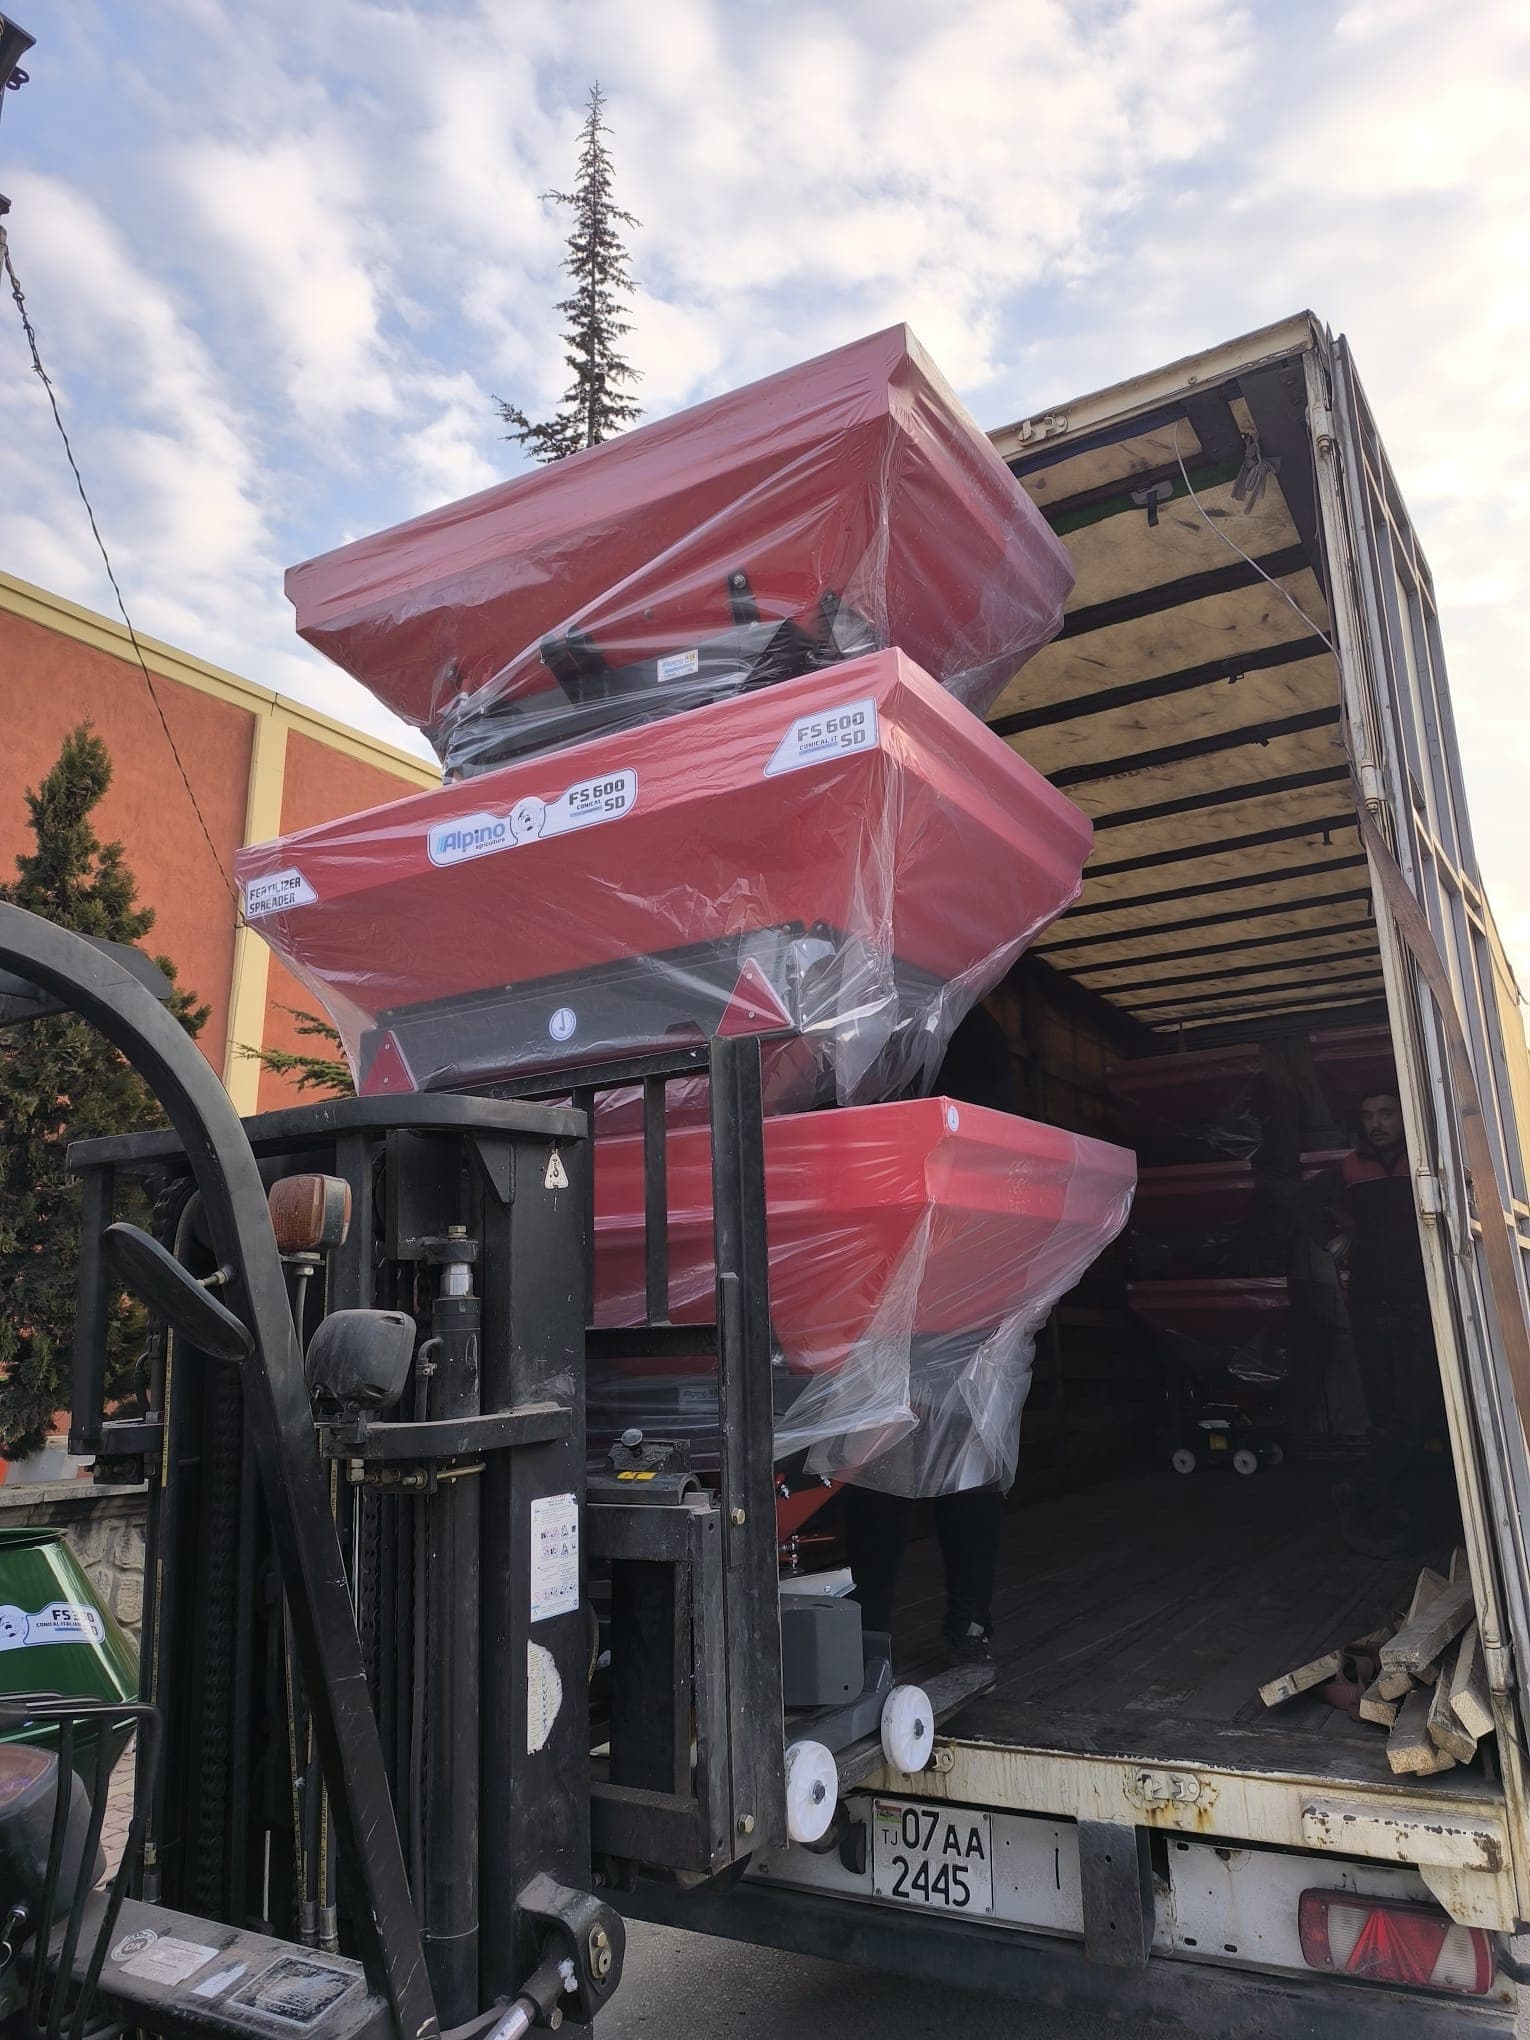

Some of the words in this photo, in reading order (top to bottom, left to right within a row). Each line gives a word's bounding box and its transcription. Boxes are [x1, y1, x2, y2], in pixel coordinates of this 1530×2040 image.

[797, 723, 822, 742] FS
[826, 711, 865, 734] 600
[841, 729, 866, 748] SD
[569, 788, 590, 806] FS
[593, 778, 625, 798] 600
[604, 795, 625, 812] SD
[439, 822, 506, 853] Alpino
[248, 892, 296, 915] SPREADER
[52, 1609, 71, 1621] FS
[881, 1828, 898, 1846] TJ
[901, 1807, 940, 1852] 07
[942, 1824, 985, 1860] AA
[891, 1855, 970, 1907] 2445
